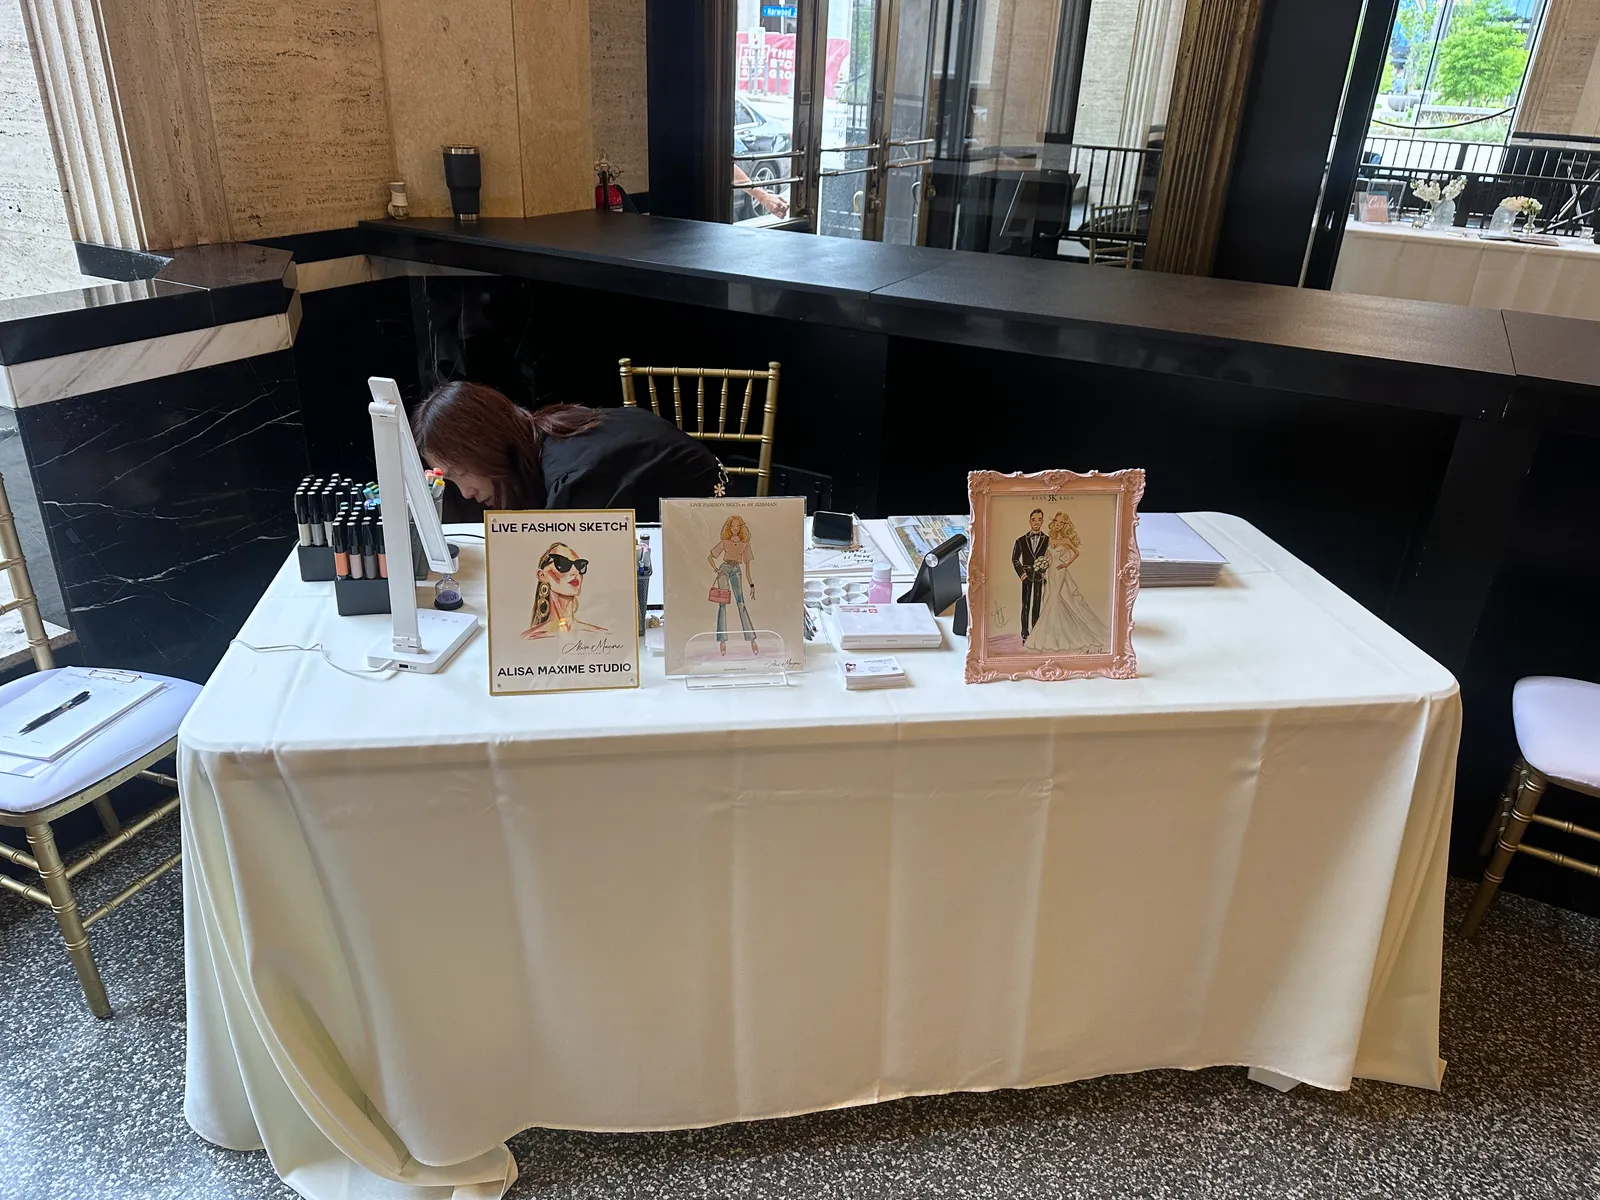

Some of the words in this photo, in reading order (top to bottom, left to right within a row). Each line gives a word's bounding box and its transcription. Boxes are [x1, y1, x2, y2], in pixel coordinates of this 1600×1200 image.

[767, 7, 792, 17] Harwood
[770, 48, 794, 58] THE
[1368, 196, 1395, 208] Cards
[491, 523, 518, 533] LIVE
[521, 522, 576, 533] FASHION
[579, 521, 628, 532] SKETCH
[497, 667, 535, 677] ALISA
[537, 664, 585, 675] MAXIME
[588, 663, 631, 674] STUDIO
